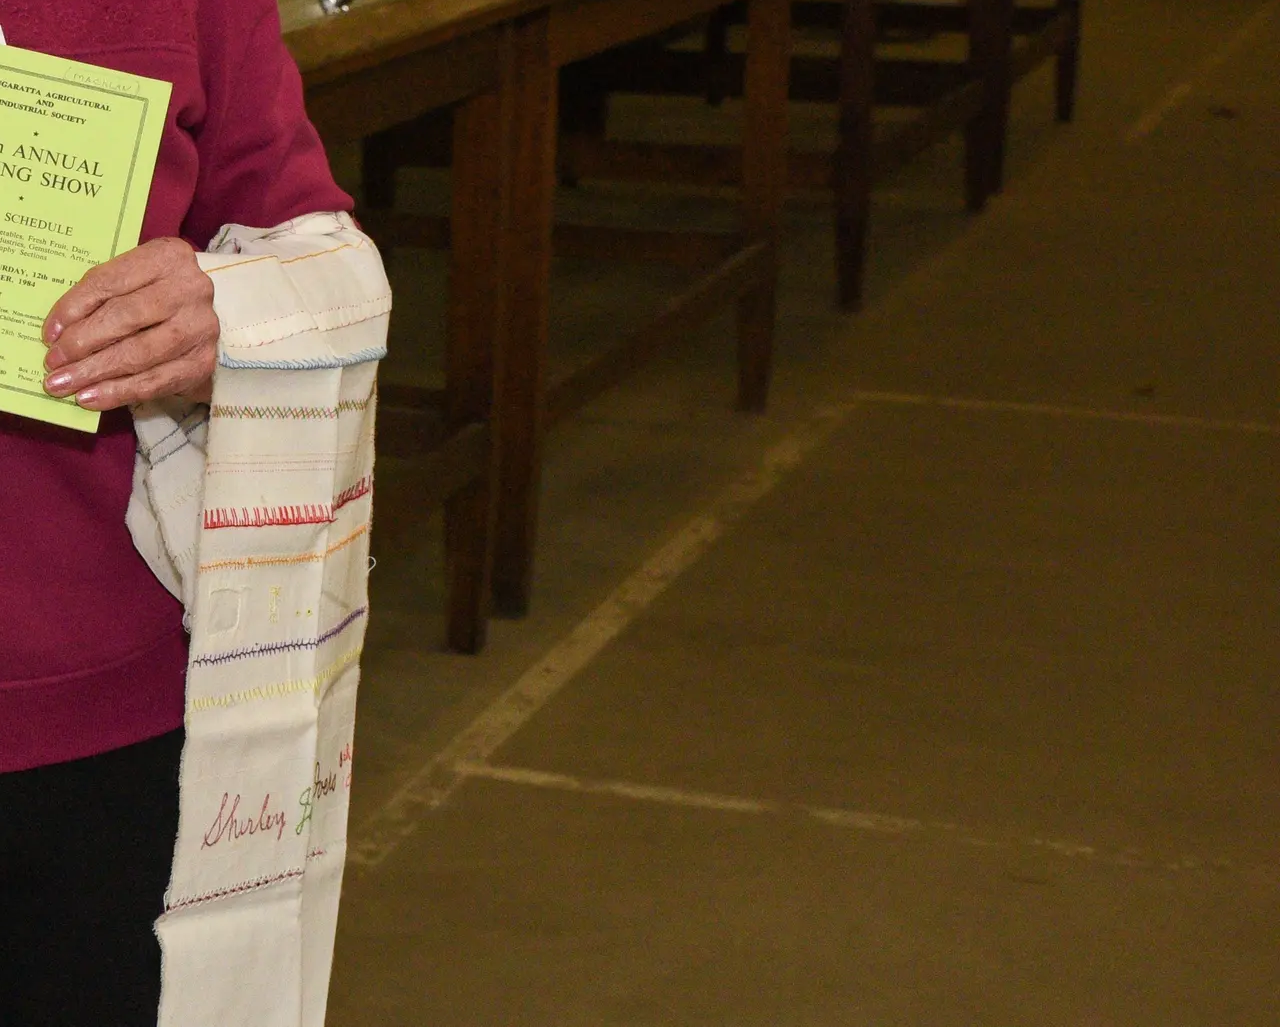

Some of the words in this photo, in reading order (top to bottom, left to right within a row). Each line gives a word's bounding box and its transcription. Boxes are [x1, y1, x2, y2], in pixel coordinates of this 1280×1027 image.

[36, 99, 54, 108] AND
[45, 91, 111, 112] AGRICULTURAL
[51, 111, 86, 125] SOCIETY
[12, 144, 103, 177] ANNUAL
[40, 173, 102, 198] SHOW
[5, 213, 73, 236] SCHEDULE
[28, 235, 47, 245] Fresh
[72, 246, 91, 256] Dairy
[20, 249, 47, 261] Sections
[70, 254, 85, 263] Arts
[18, 278, 36, 288] 1984
[32, 272, 48, 281] 12th
[52, 277, 65, 285] and
[201, 792, 286, 850] Shirley
